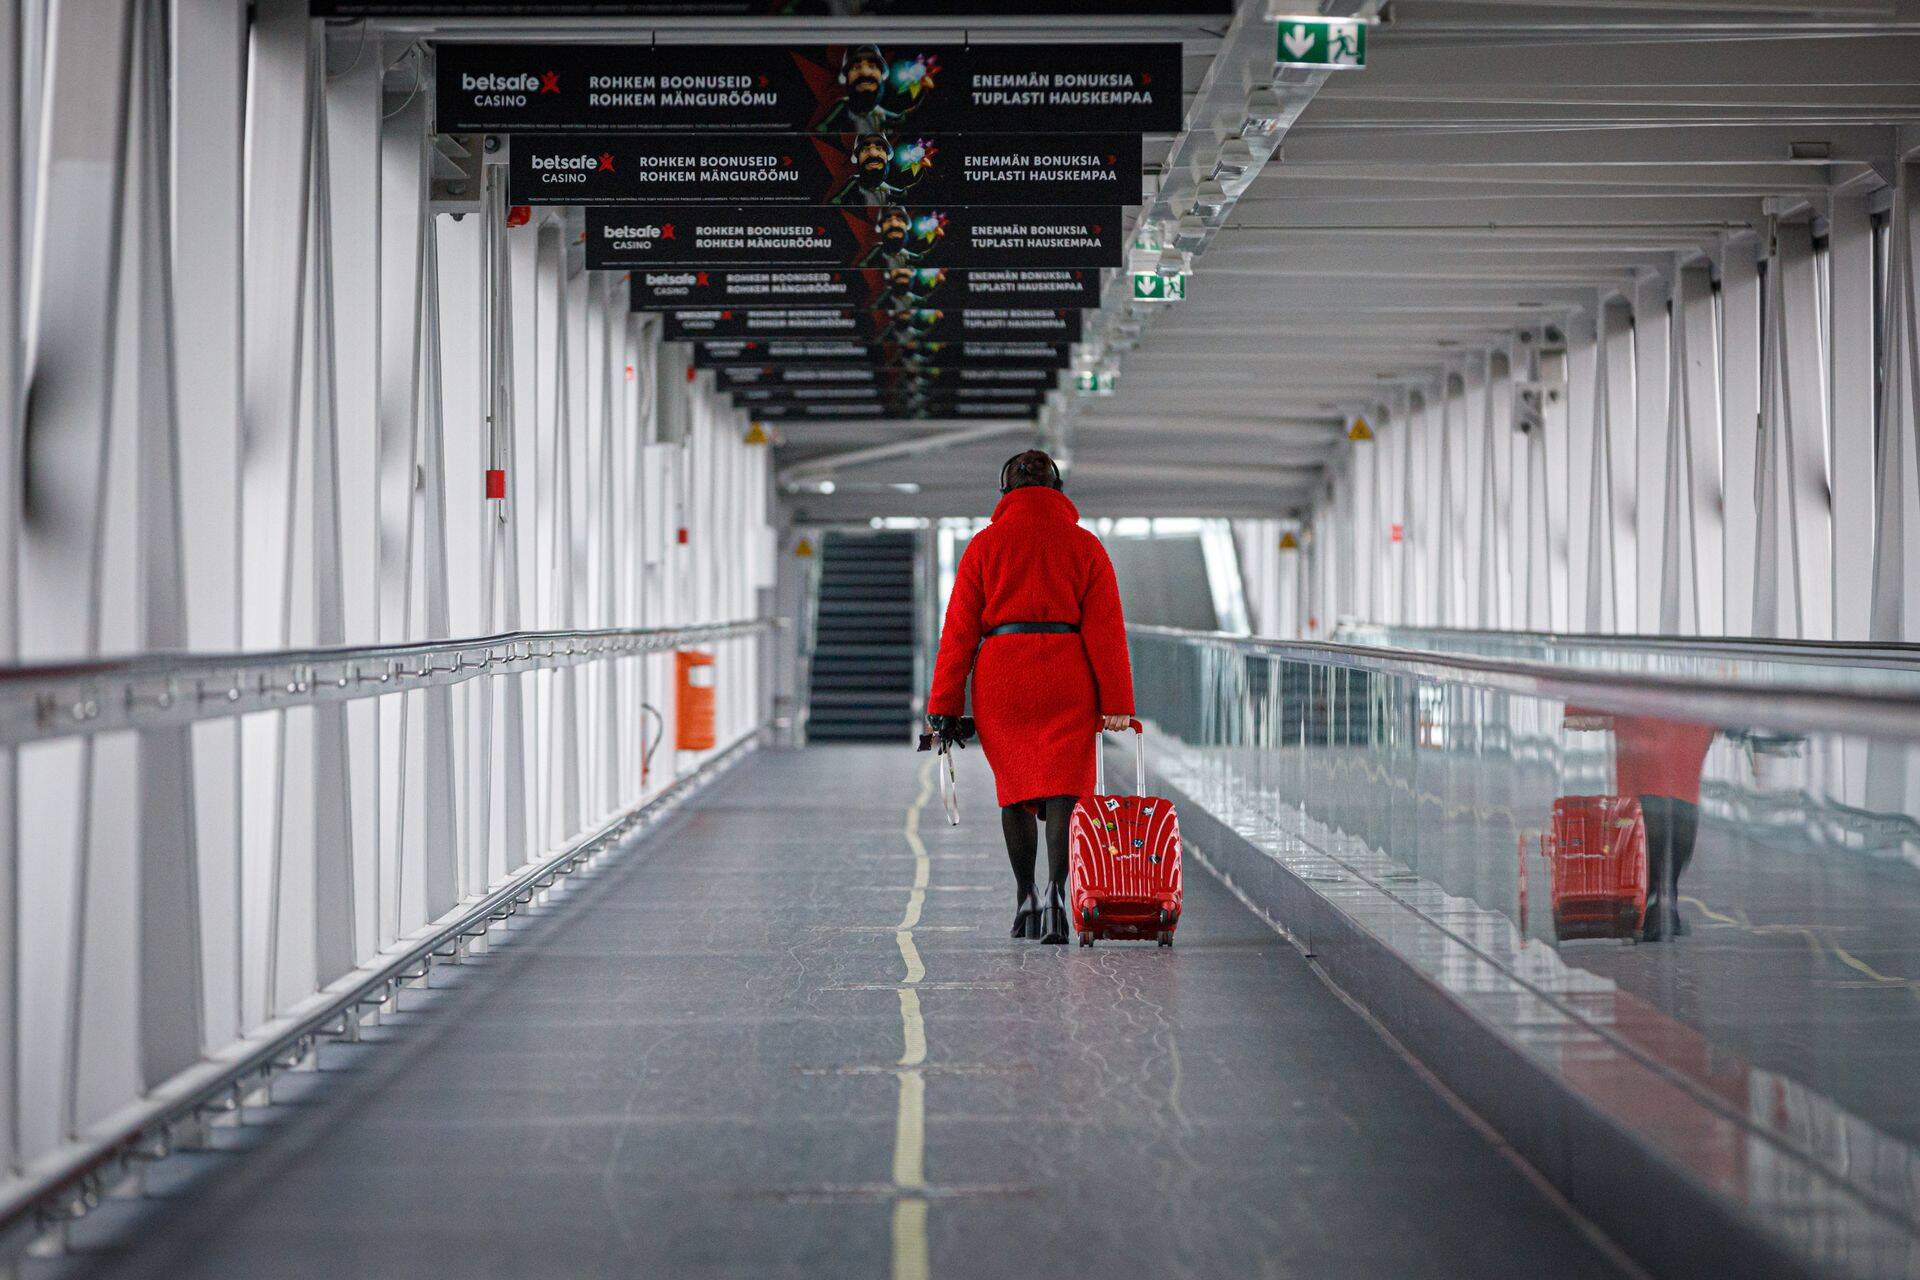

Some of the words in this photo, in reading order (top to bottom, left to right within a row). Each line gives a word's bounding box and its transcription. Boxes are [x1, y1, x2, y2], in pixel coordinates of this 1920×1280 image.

[462, 72, 540, 92] betsafe
[589, 75, 656, 89] ROHKEM
[660, 75, 752, 89] BOONUSEID
[973, 72, 1050, 88] ENEMMÄN
[1054, 73, 1134, 88] BONUKSIA
[473, 94, 528, 107] CASINO
[589, 93, 656, 107] ROHKEM
[660, 90, 778, 107] MÄNGURÕÕMU
[973, 91, 1045, 105] TUPLASTI
[1048, 91, 1153, 105] HAUSKEMPAA
[531, 154, 598, 170] betsafe
[639, 156, 696, 167] ROHKEM
[699, 156, 778, 167] BOONUSEID
[965, 155, 1030, 167] ENEMMÄN
[1033, 155, 1101, 167] BONUKSIA
[541, 173, 587, 183] CASINO
[639, 171, 696, 182] ROHKEM
[699, 168, 799, 182] MÄNGURÕÕMU
[965, 170, 1026, 182] TUPLASTI
[1029, 170, 1117, 182] HAUSKEMPAA
[603, 224, 661, 239] betsafe
[695, 226, 745, 236] ROHKEM
[746, 225, 814, 236] BOONUSEID
[971, 224, 1028, 236] ENEMMÄN
[1030, 225, 1088, 236] BONUKSIA
[612, 240, 652, 250] CASINO
[695, 238, 745, 249] ROHKEM
[972, 238, 1024, 249] TUPLASTI
[1026, 237, 1102, 249] HAUSKEMPAA
